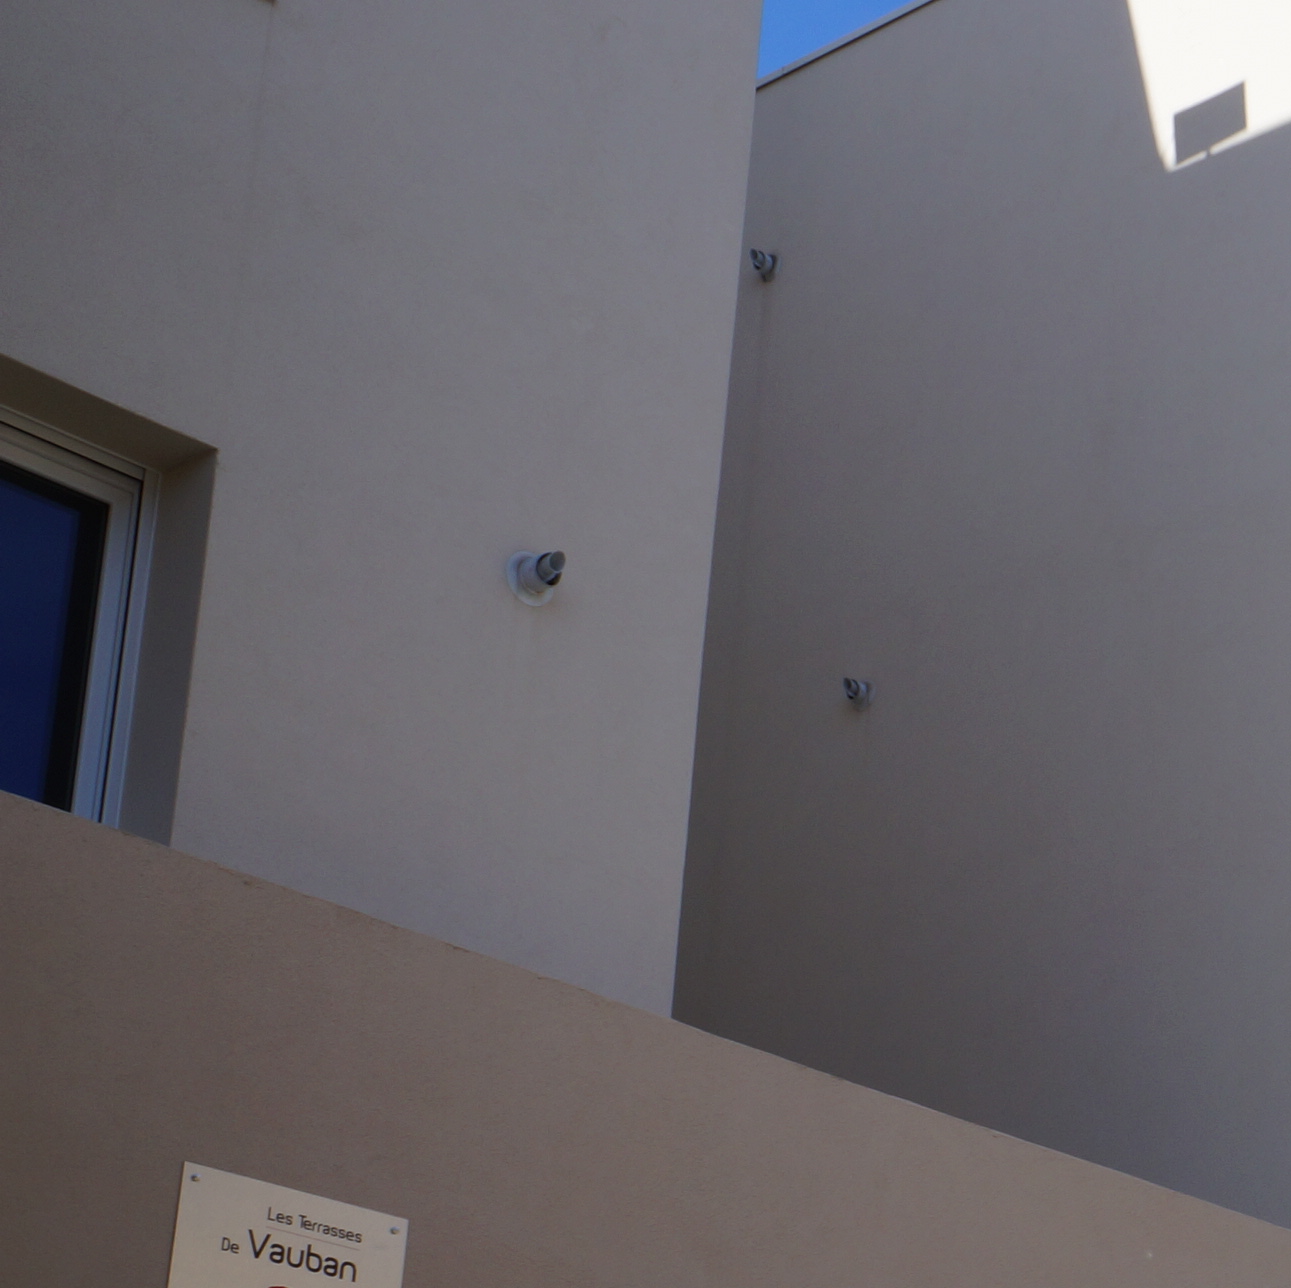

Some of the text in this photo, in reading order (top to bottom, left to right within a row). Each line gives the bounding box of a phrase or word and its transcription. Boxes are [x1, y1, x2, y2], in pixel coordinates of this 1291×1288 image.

[267, 1206, 363, 1244] Les Terrasses
[221, 1229, 357, 1283] De Vauban
